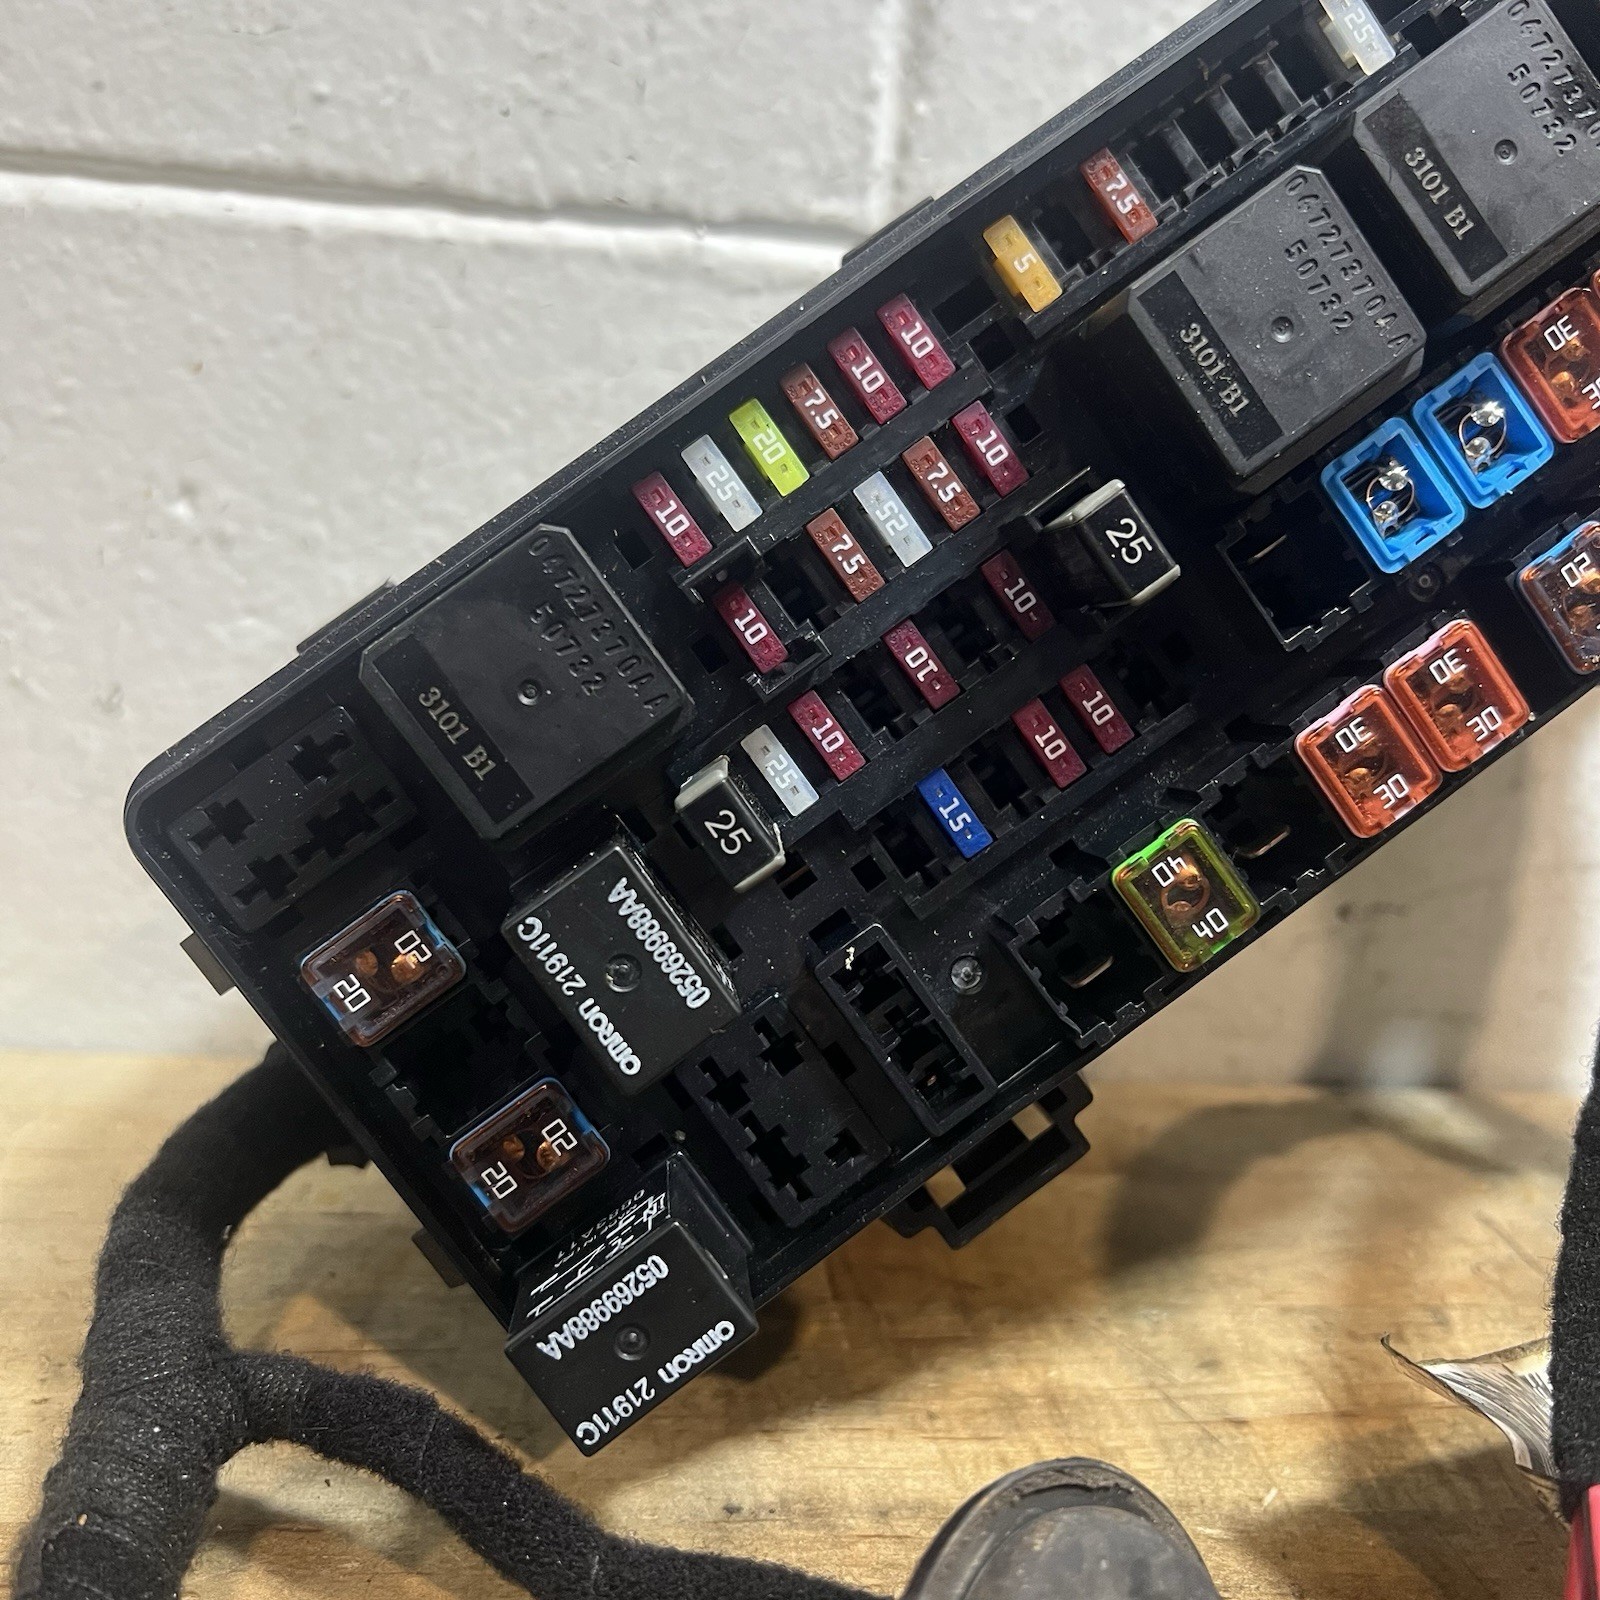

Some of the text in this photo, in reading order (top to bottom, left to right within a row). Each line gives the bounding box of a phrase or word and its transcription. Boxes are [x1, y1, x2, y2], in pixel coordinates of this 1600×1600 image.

[1344, 8, 1372, 43] 25
[1104, 176, 1141, 214] 7.5
[1404, 147, 1475, 240] 3101 B1
[1013, 252, 1037, 274] 5
[901, 321, 934, 359] 10
[1543, 315, 1580, 351] 30
[852, 356, 885, 394] 10
[1179, 322, 1250, 418] 3101 B1
[804, 388, 839, 430] 7.5
[1581, 376, 1600, 410] 3
[752, 428, 787, 465] 20
[975, 428, 1009, 466] 10
[706, 464, 740, 501] 25
[927, 461, 962, 503] 7.5
[655, 499, 690, 537] 10
[875, 501, 909, 537] 25
[831, 534, 866, 575] 7.5
[1105, 518, 1153, 566] 25
[1561, 551, 1597, 588] 20
[1004, 577, 1037, 614] 10
[734, 607, 766, 645] 10
[905, 646, 938, 682] 10
[1428, 647, 1468, 685] 30
[1082, 689, 1115, 726] 10
[1465, 706, 1502, 743] 30
[418, 686, 497, 782] 3101 B1
[811, 717, 845, 753] 10
[1034, 726, 1067, 762] 10
[1334, 716, 1374, 753] 30
[766, 753, 799, 790] 25
[1374, 773, 1410, 810] 30
[703, 809, 752, 856] 25
[938, 796, 972, 832] 15
[1151, 854, 1188, 888] 40
[607, 877, 711, 1009] 05269988AA
[1191, 907, 1230, 942] 40
[394, 929, 432, 965] 20
[517, 916, 587, 996] 21911C
[332, 973, 373, 1013] 20
[541, 1118, 578, 1157] 20
[480, 1161, 519, 1200] 20
[536, 1254, 669, 1361] 05269988AA
[575, 1376, 656, 1446] 21911C
